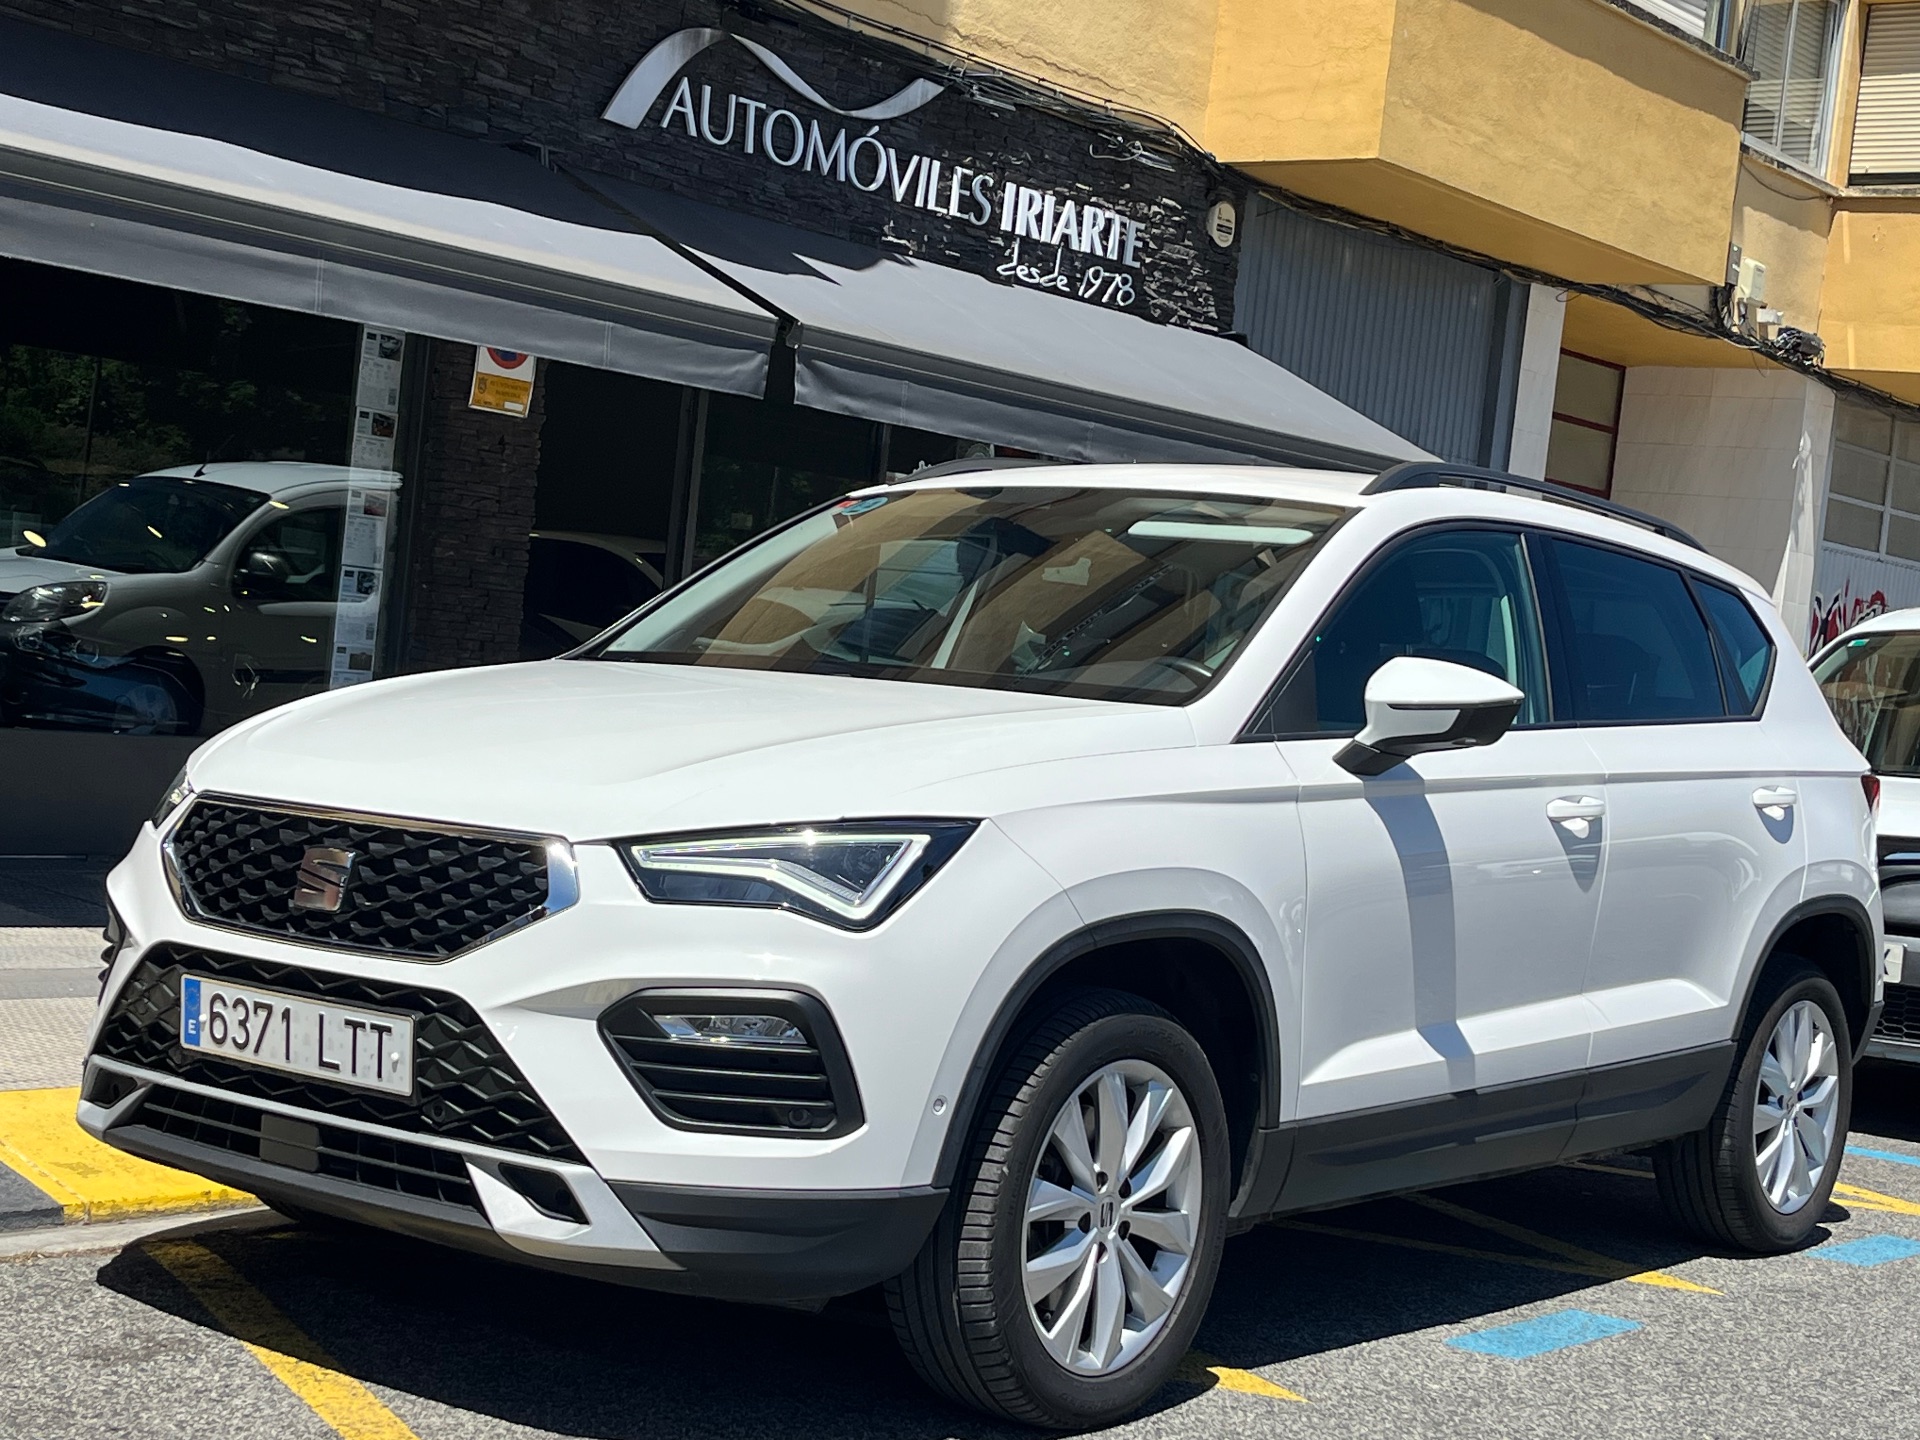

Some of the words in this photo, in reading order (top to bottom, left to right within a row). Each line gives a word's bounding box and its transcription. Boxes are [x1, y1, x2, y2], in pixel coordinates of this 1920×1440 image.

[660, 76, 994, 226] AUTOMÓVILES
[1000, 181, 1146, 269] IRIARTE
[996, 237, 1070, 292] desde
[1077, 266, 1136, 306] 1978
[209, 992, 291, 1063] 6371
[318, 1011, 393, 1081] LTT
